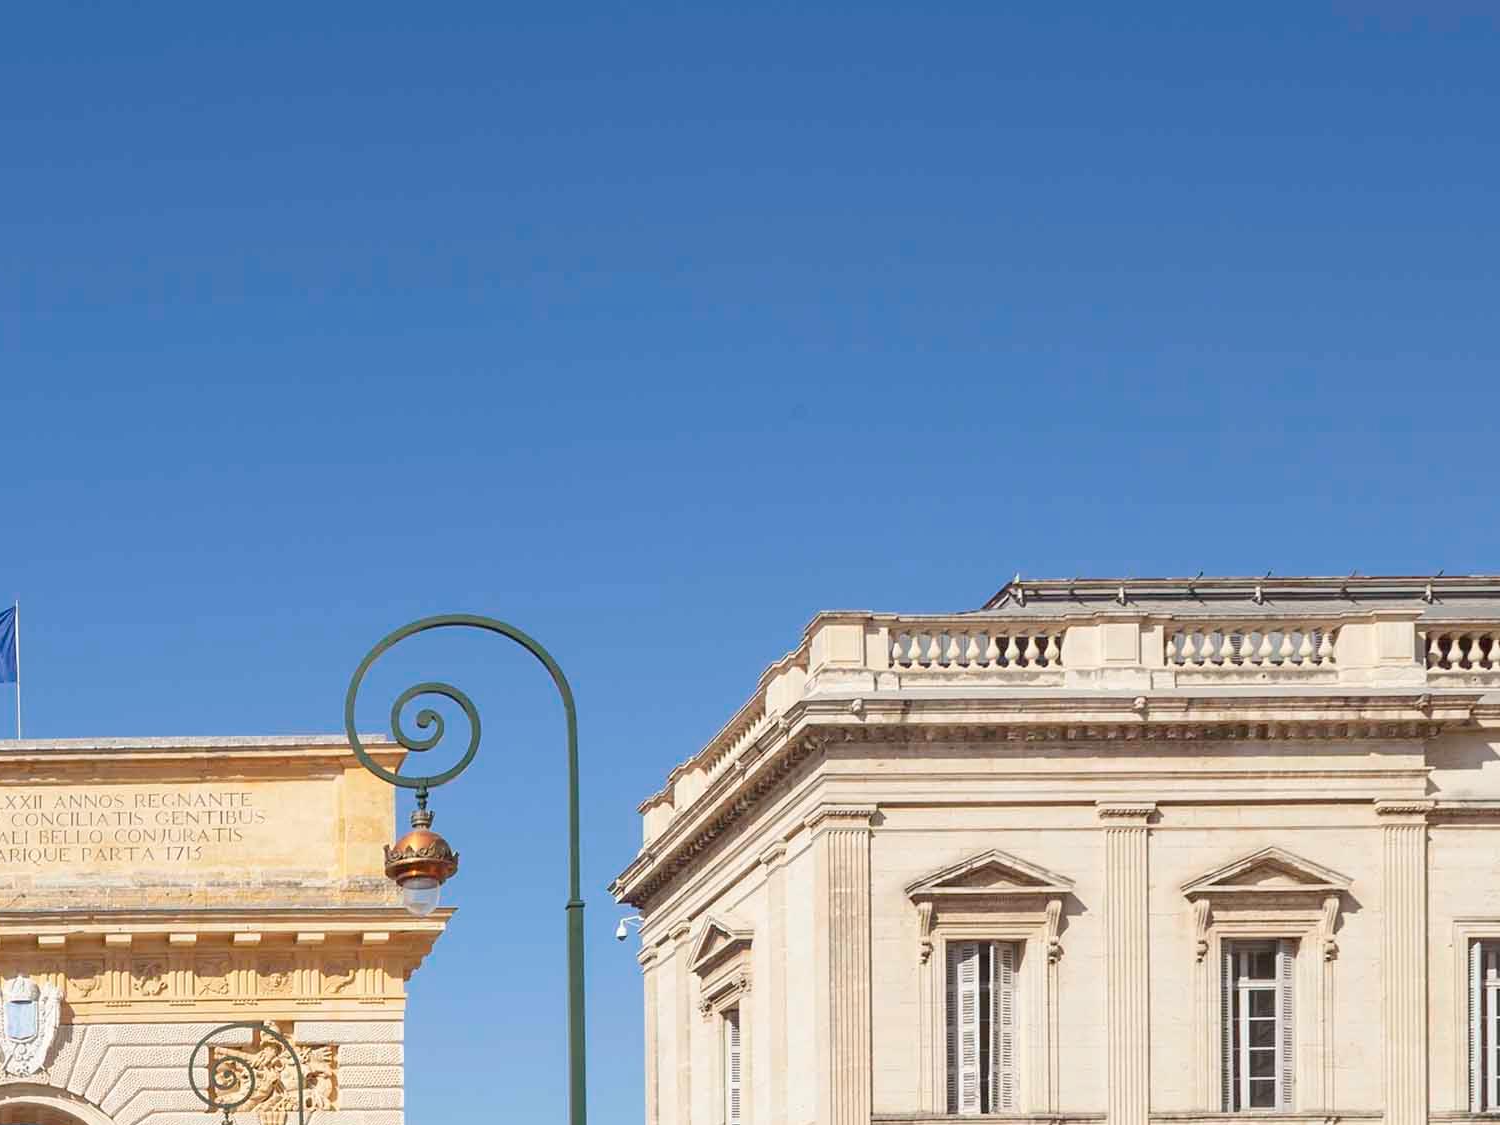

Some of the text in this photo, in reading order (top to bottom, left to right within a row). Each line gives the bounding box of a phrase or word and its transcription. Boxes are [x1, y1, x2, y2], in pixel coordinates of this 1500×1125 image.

[54, 793, 125, 809] ANNOS
[134, 792, 253, 808] REGNANTE
[11, 811, 144, 827] CONCILIATIS
[155, 810, 266, 825] GENTIBUS
[39, 829, 103, 845] BELLO
[114, 827, 244, 844] CONJURATIS
[82, 847, 155, 862] PARTA
[166, 846, 202, 861] 1715
